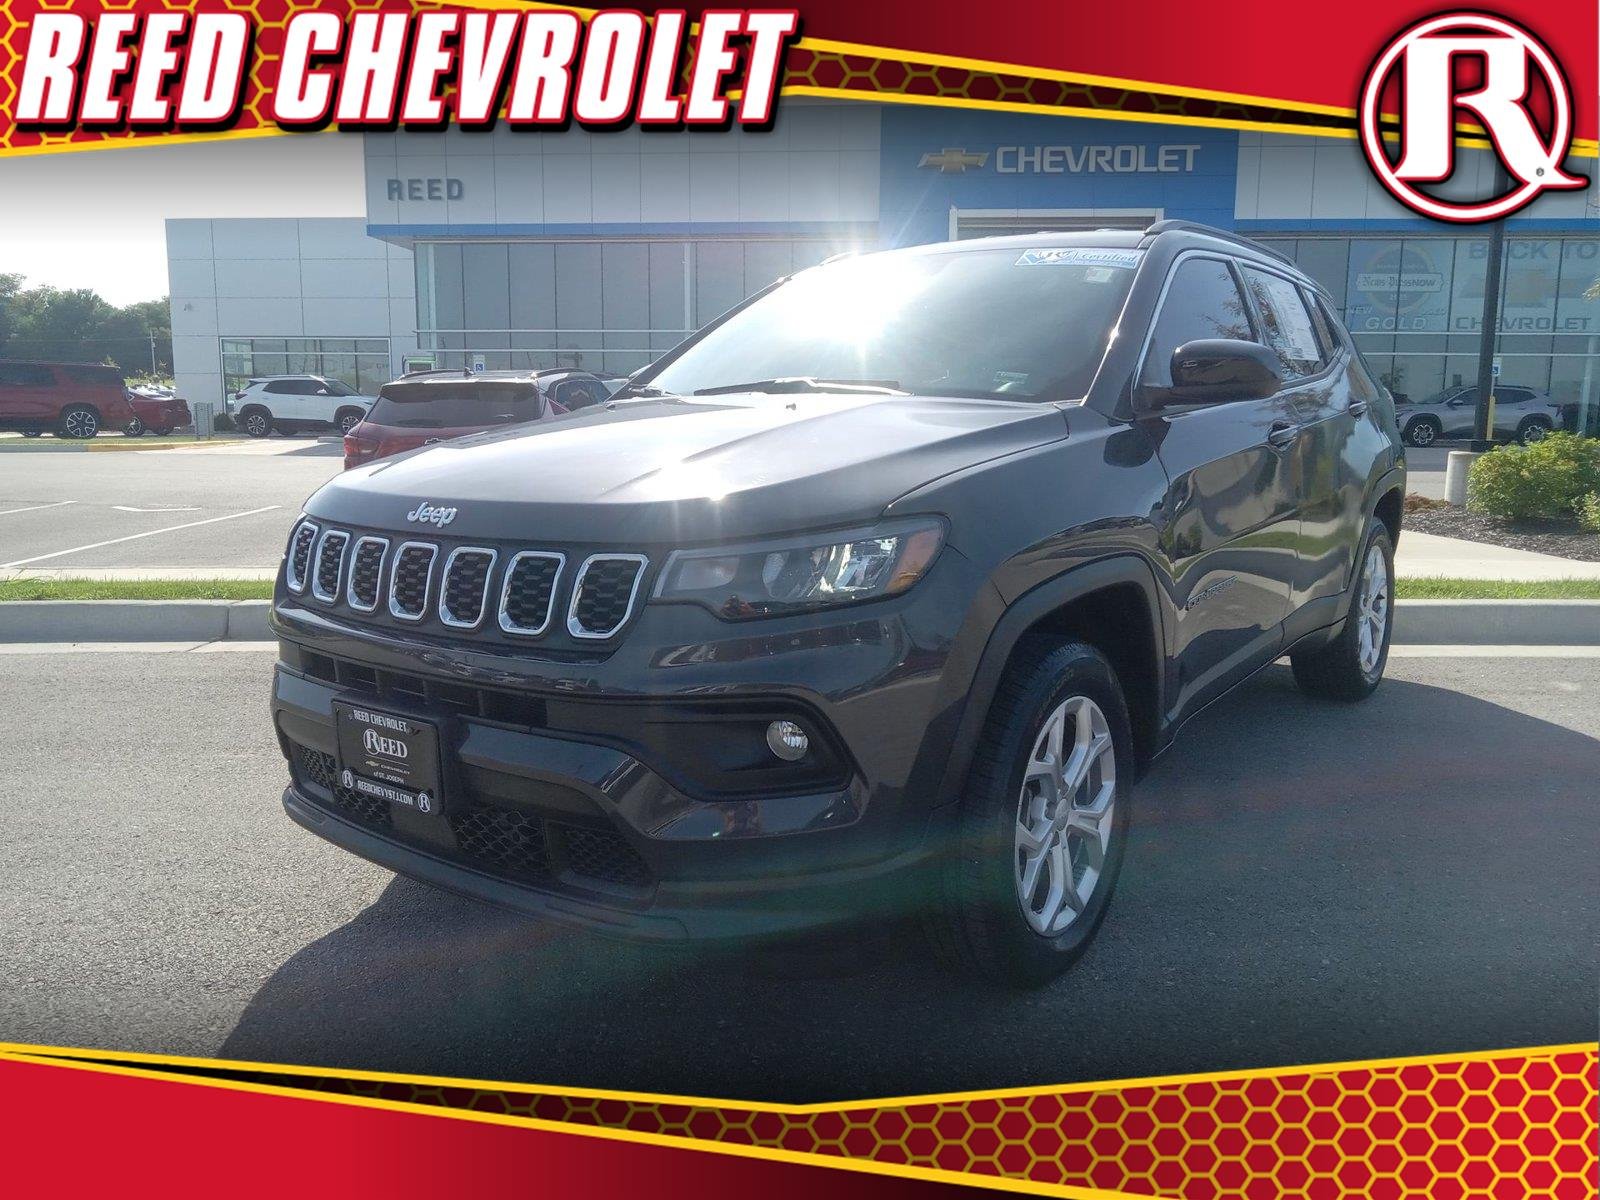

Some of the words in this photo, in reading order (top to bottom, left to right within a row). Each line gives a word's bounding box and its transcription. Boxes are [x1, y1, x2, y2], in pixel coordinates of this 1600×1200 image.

[995, 144, 1201, 173] CHEVROLET
[386, 178, 464, 201] REED
[1469, 241, 1549, 260] BCK
[1364, 316, 1429, 331] GOLD
[406, 501, 458, 528] Jeep
[353, 710, 370, 722] REED
[371, 714, 407, 732] CHEVROLET
